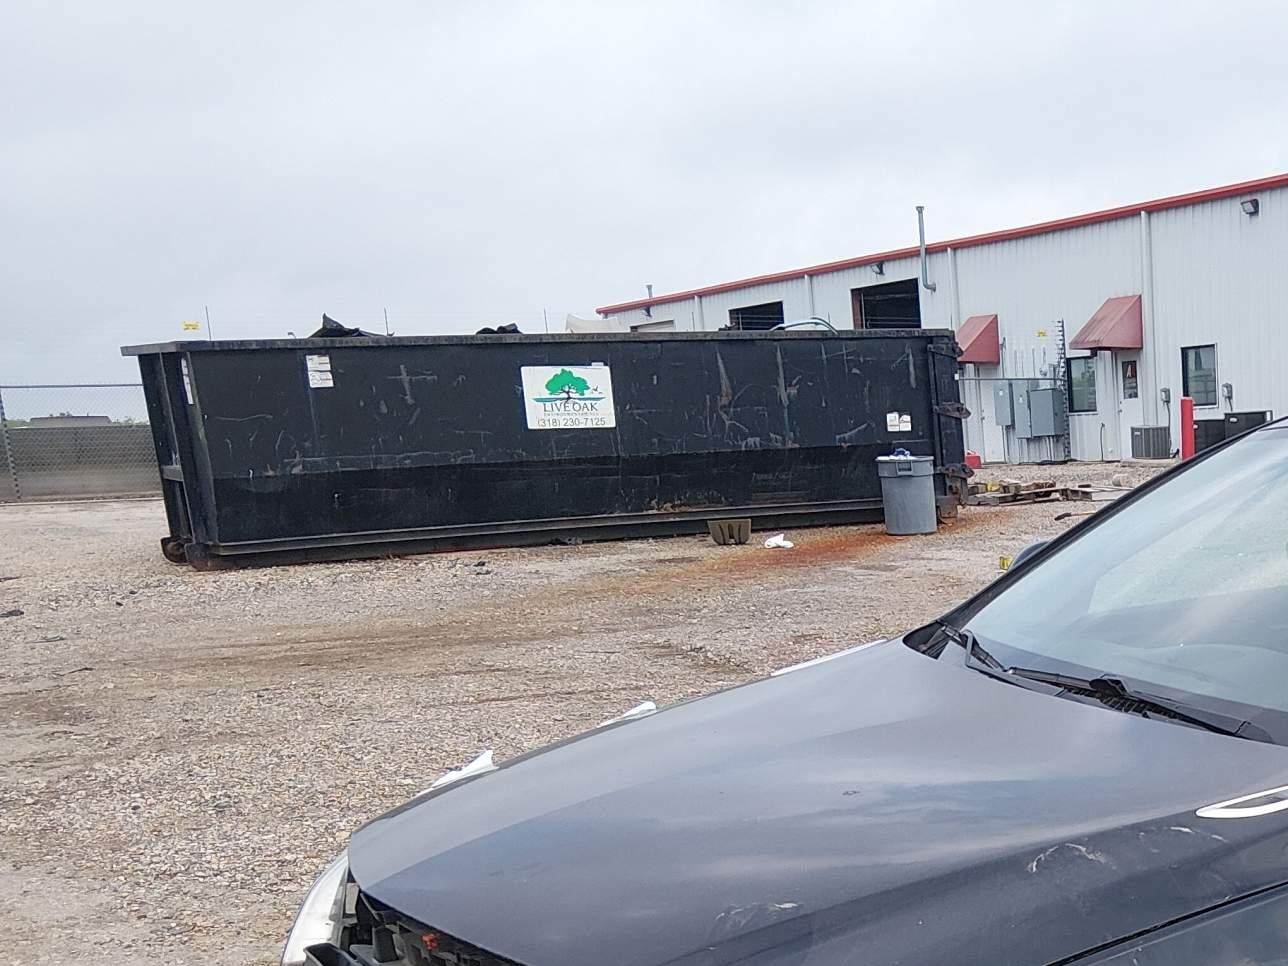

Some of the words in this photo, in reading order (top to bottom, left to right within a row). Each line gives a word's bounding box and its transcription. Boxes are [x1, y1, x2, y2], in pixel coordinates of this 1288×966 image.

[543, 402, 570, 412] LIVE
[571, 402, 599, 412] OAK
[537, 418, 561, 427] (318)
[562, 417, 606, 427] 230-7125
